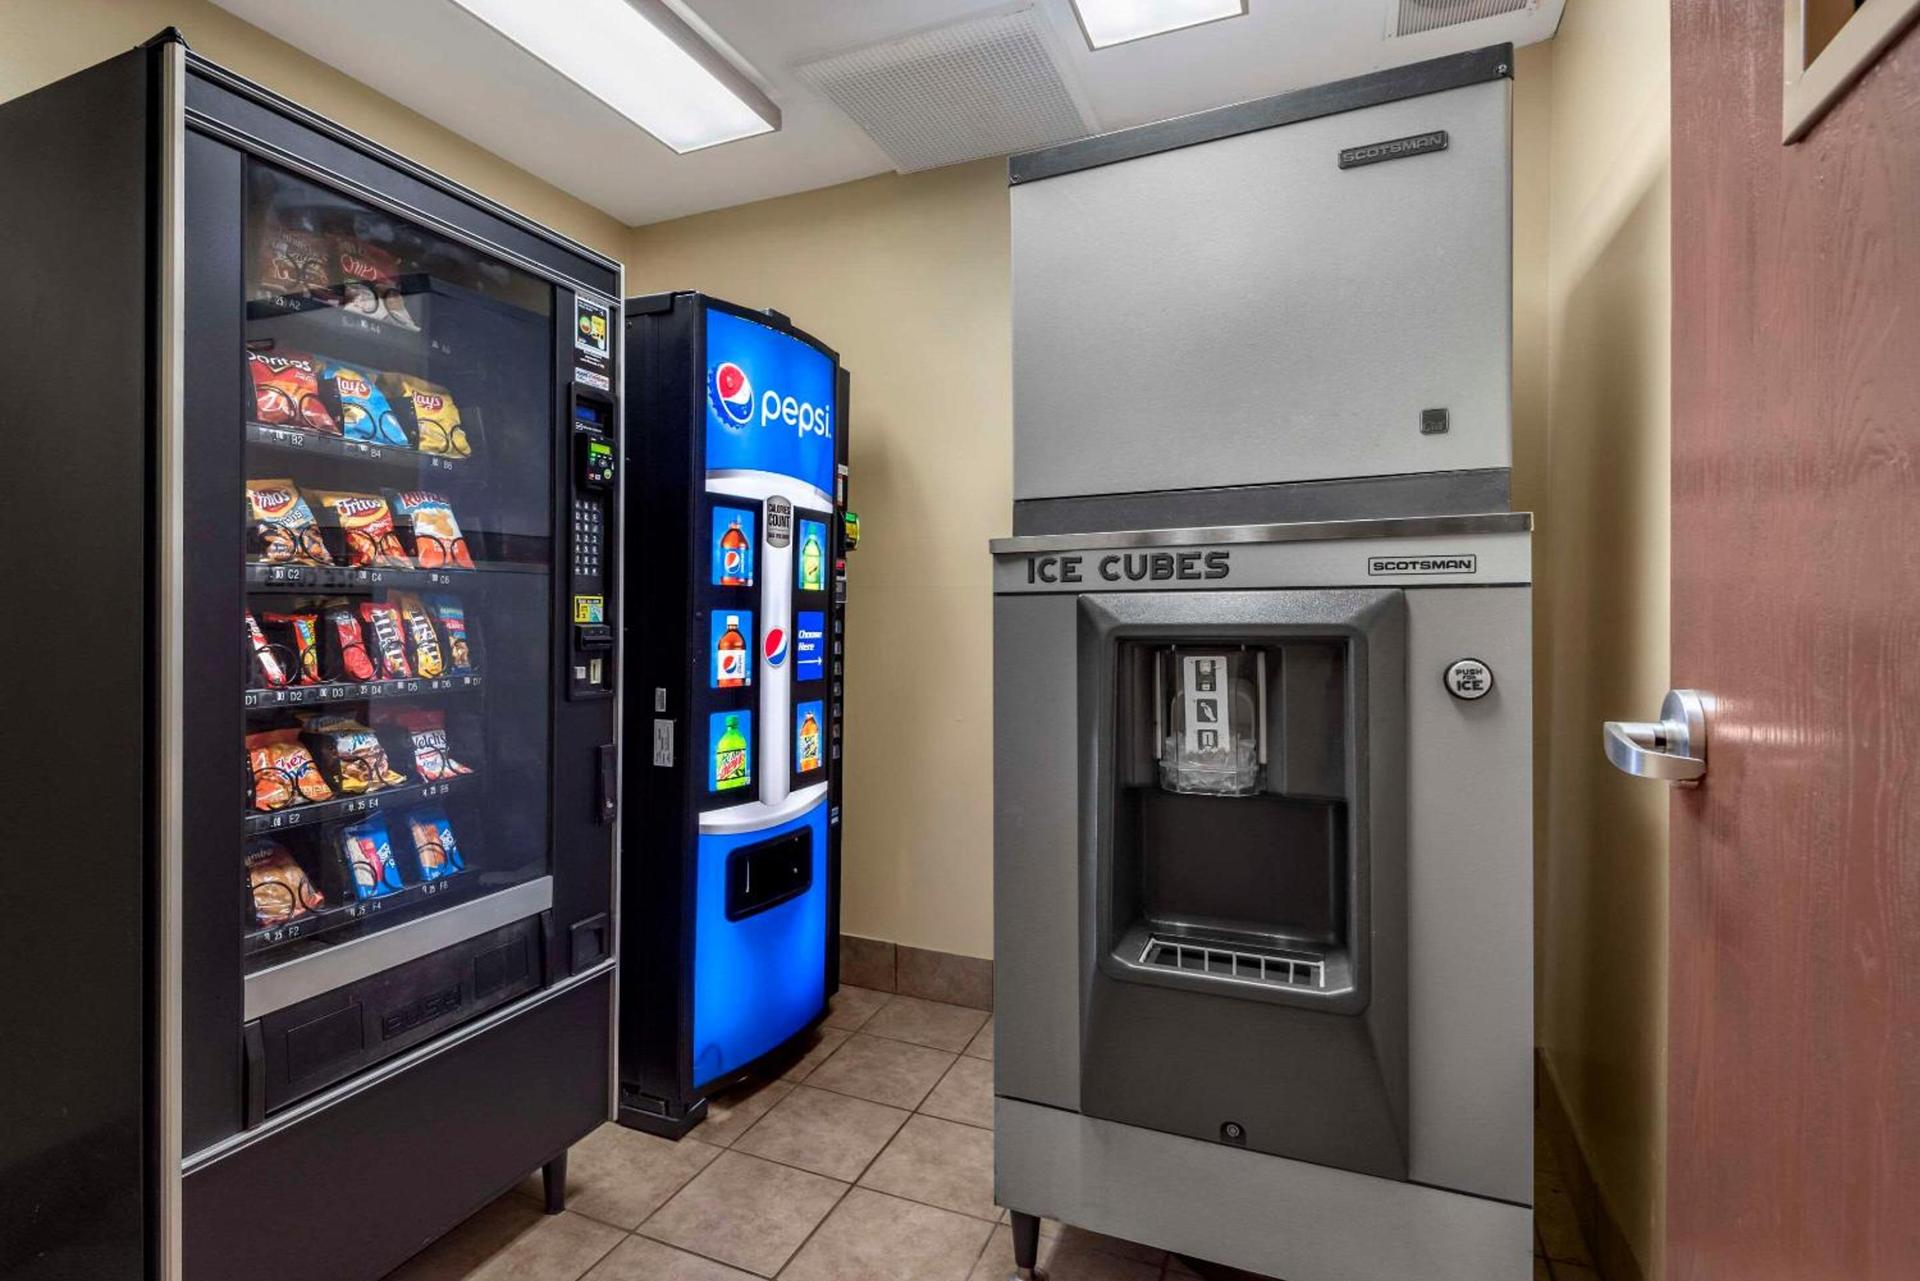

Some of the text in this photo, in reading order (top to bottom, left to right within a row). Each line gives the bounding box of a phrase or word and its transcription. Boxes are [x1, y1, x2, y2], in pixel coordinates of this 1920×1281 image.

[1342, 135, 1441, 163] SCOTSMAN
[760, 389, 831, 438] pepsi
[335, 497, 382, 517] Fritos
[1027, 551, 1230, 584] ICE CUBES
[1373, 559, 1472, 571] SCOTSMAN
[287, 568, 300, 580] C2
[371, 572, 383, 583] C4
[1455, 668, 1483, 676] PUSH
[371, 685, 383, 695] D4
[1456, 680, 1483, 692] ICE
[290, 691, 303, 701] D2
[332, 688, 344, 698] D3
[245, 695, 257, 706] D1
[289, 813, 301, 824] E2
[288, 926, 300, 937] F2
